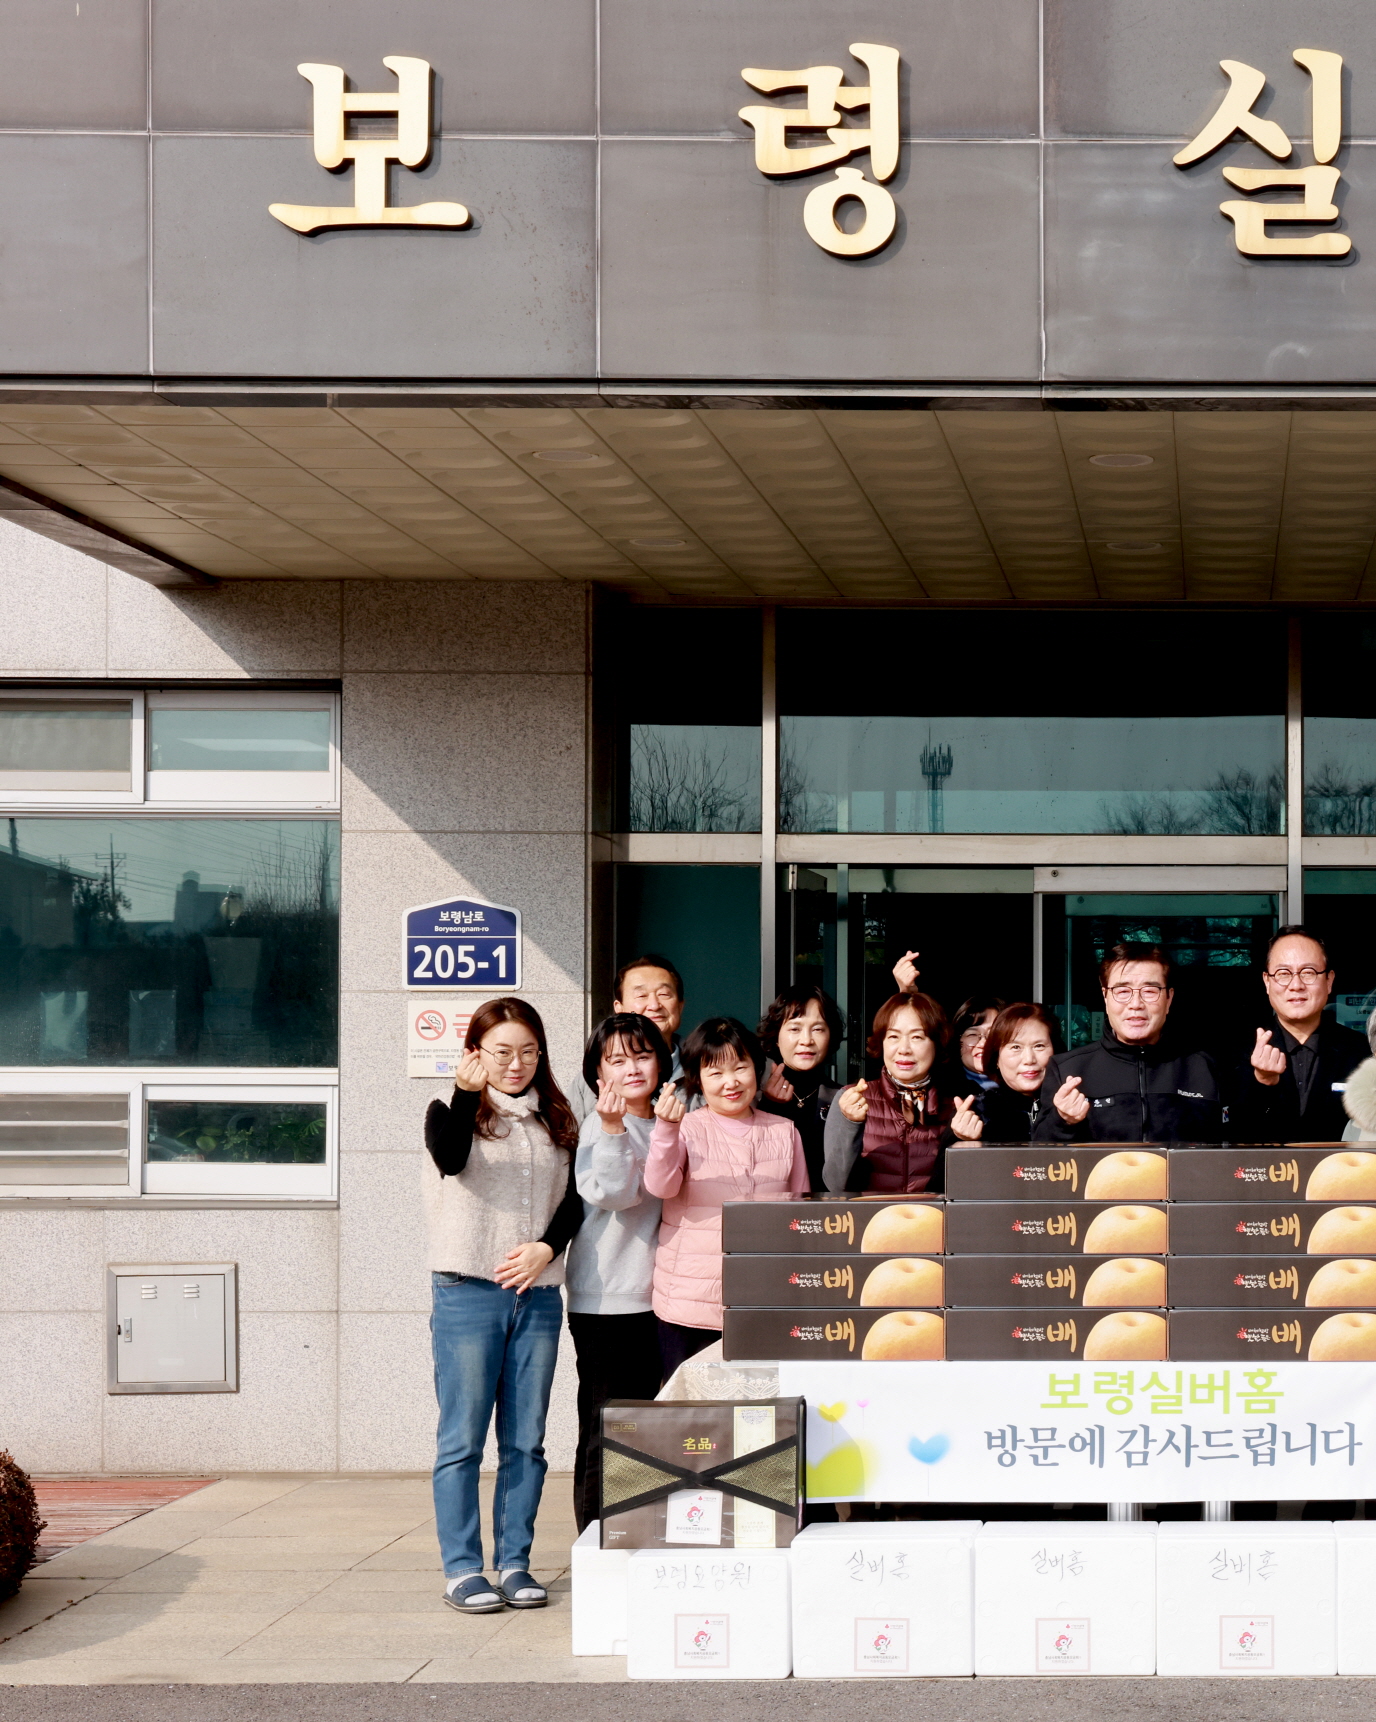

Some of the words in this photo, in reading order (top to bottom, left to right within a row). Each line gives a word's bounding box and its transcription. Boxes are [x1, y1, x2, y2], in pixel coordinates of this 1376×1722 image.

[434, 925, 489, 933] Boryeongnam-ro
[439, 911, 485, 924] 보령남로
[413, 944, 506, 979] 205-1
[1048, 1158, 1078, 1192] 배
[1269, 1159, 1299, 1193] 배
[825, 1211, 854, 1245] 배
[1047, 1212, 1076, 1246] 배
[1271, 1213, 1300, 1247] 배
[824, 1265, 853, 1298] 배
[1046, 1265, 1076, 1299] 배
[1269, 1266, 1298, 1300] 배
[825, 1318, 855, 1351] 배
[1047, 1319, 1076, 1352] 배
[1272, 1320, 1301, 1353] 배
[1039, 1368, 1285, 1416] 보령실버홈
[682, 1437, 712, 1451] 名品
[984, 1423, 1105, 1468] 방문에
[1115, 1421, 1363, 1468] 감사드립니다
[653, 1562, 754, 1591] 보령요양원
[845, 1549, 911, 1587] 실버홈
[1030, 1547, 1087, 1582] 실버홈
[1208, 1547, 1278, 1586] 실버홈
